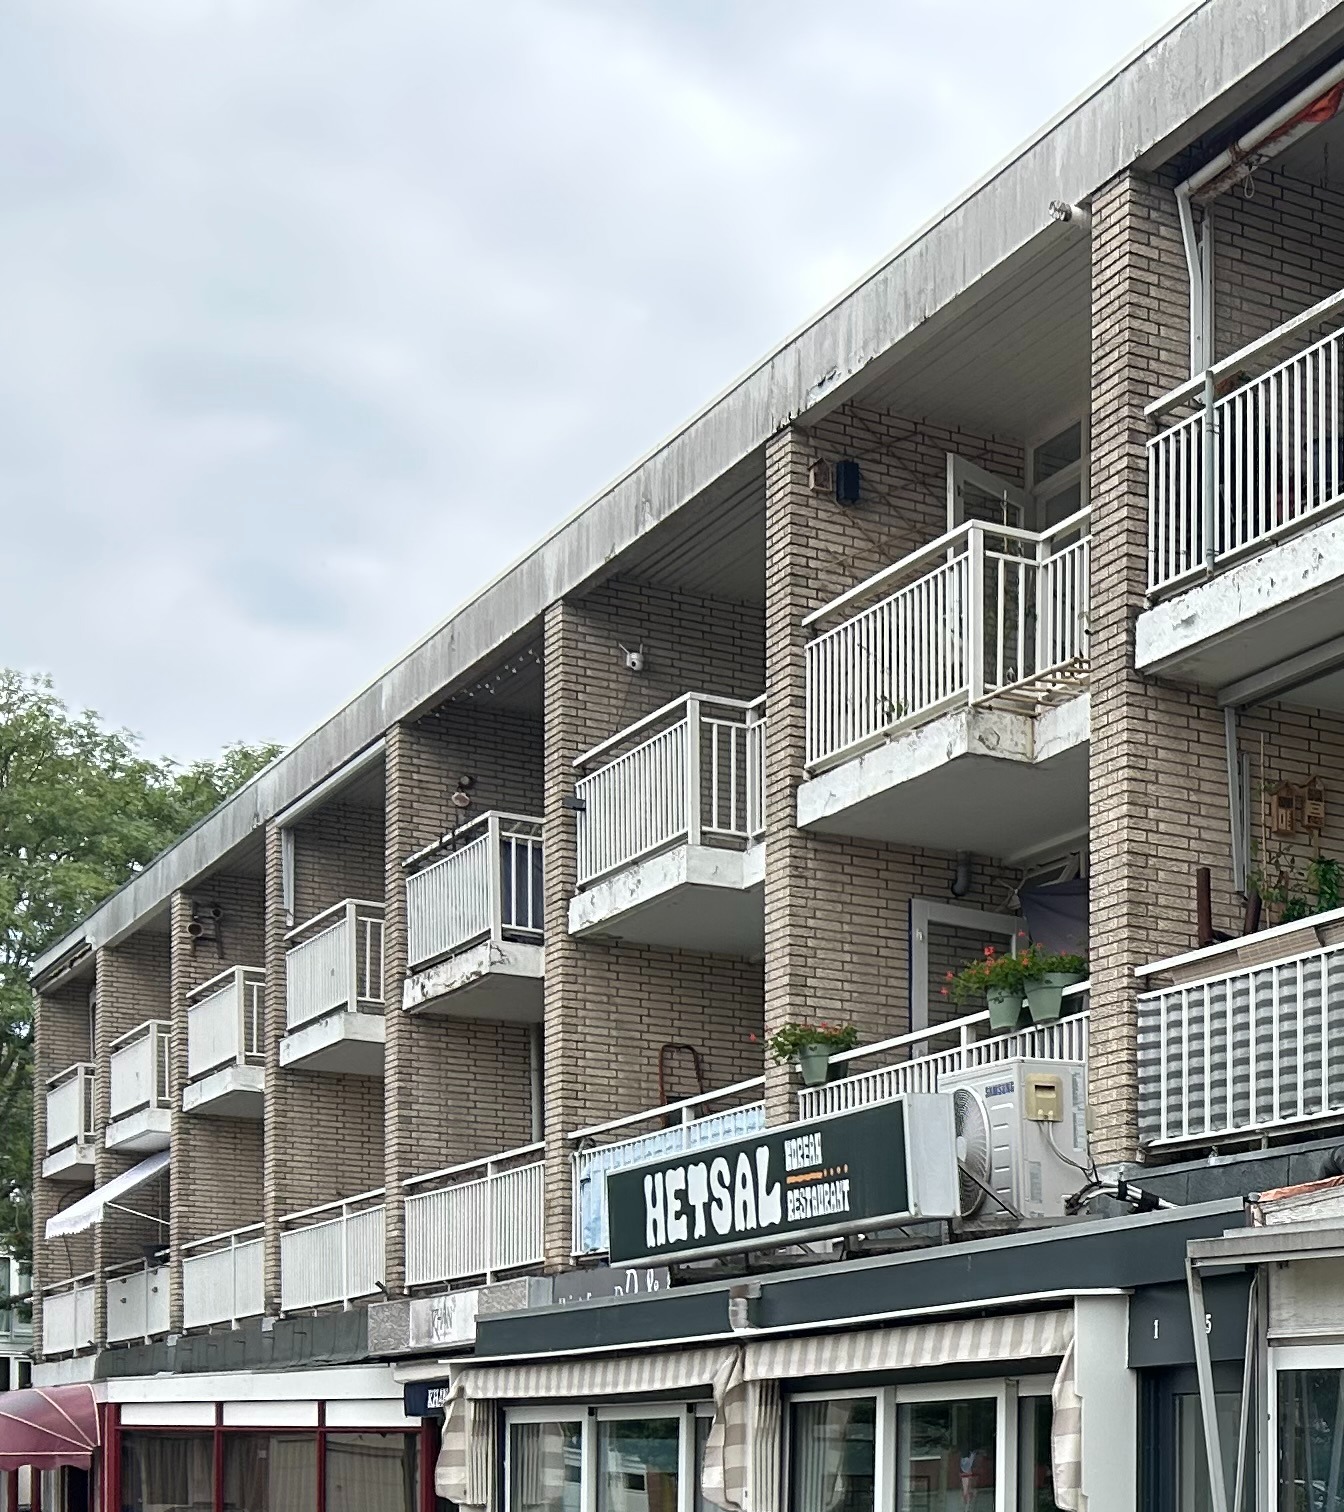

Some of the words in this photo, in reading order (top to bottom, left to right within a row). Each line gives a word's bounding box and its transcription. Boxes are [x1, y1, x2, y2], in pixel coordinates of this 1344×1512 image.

[985, 1081, 1015, 1098] SAMSUNG
[784, 1132, 823, 1172] KOREAN
[643, 1145, 782, 1248] HETSAL
[787, 1178, 850, 1222] RESTAURANT
